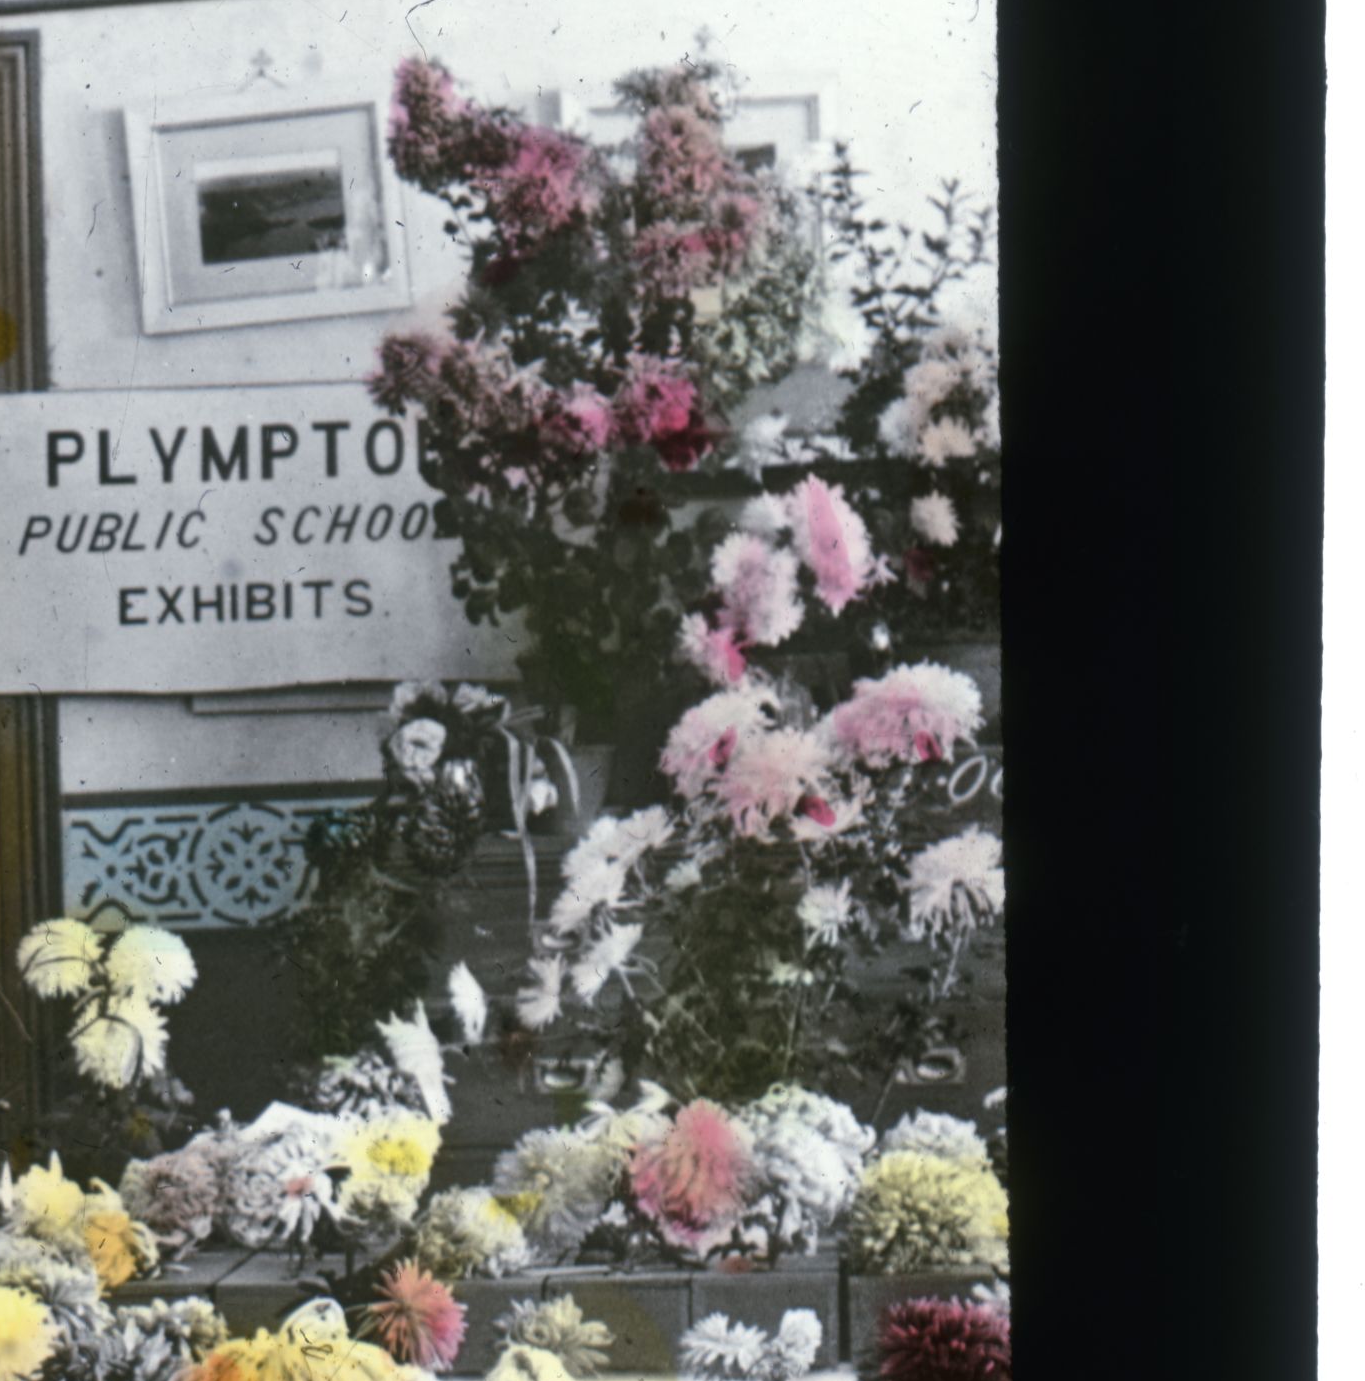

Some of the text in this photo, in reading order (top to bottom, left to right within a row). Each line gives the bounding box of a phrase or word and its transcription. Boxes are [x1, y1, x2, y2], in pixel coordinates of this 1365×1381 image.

[46, 419, 435, 486] PLYMPTO
[19, 508, 206, 556] PUBLIC
[118, 578, 373, 626] EXHIBITS
